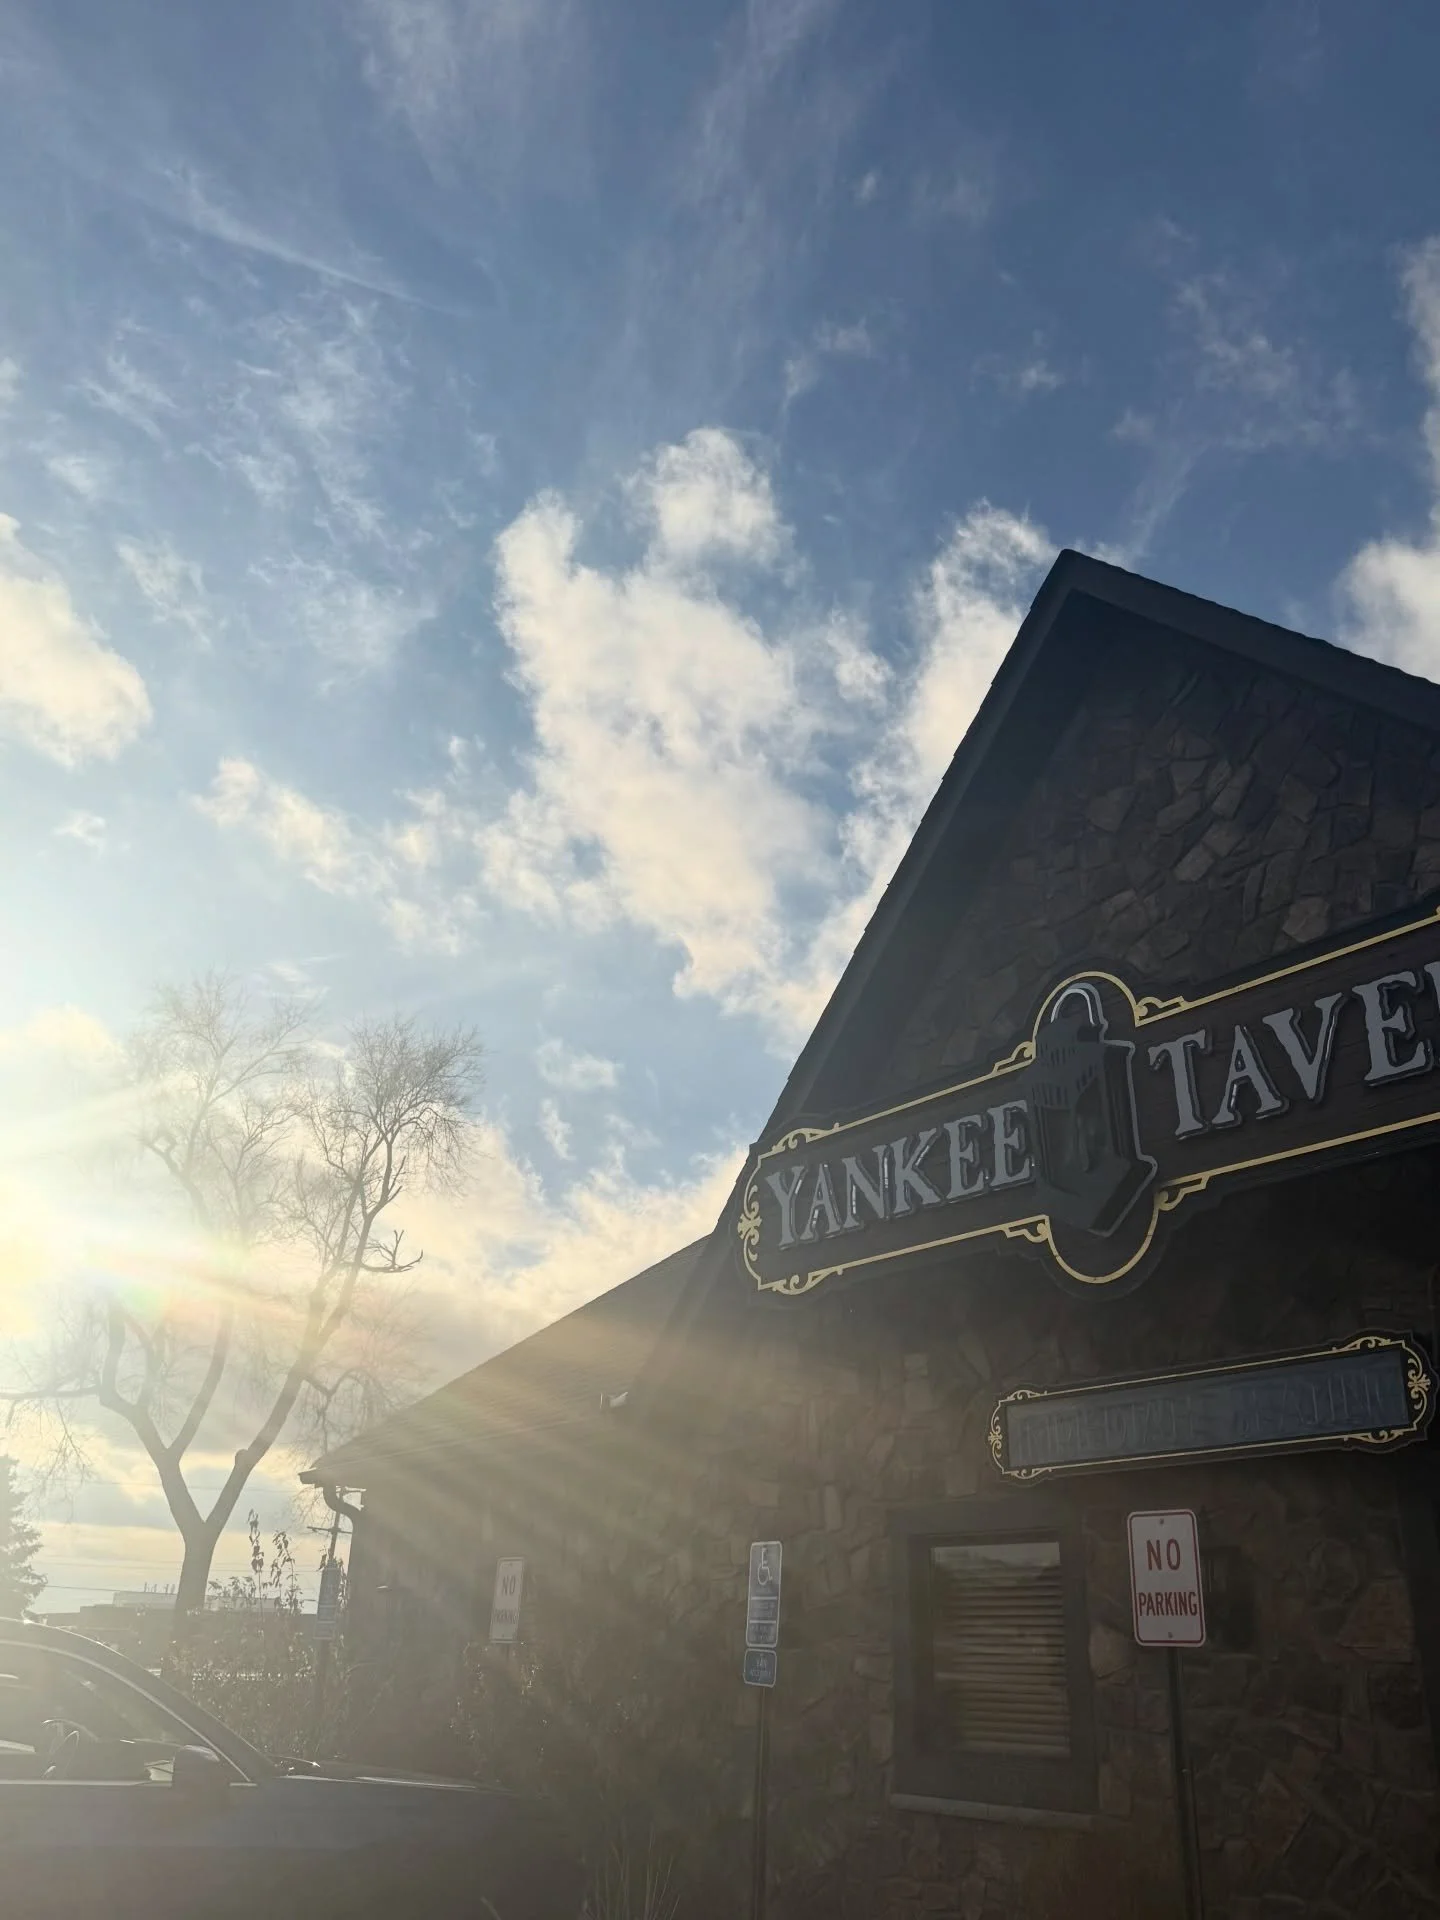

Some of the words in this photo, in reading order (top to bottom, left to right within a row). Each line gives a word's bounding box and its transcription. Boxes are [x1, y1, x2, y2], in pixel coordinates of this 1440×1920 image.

[767, 1098, 1036, 1249] YANKEE
[1146, 1538, 1181, 1571] NO
[501, 1574, 517, 1597] NO
[1138, 1591, 1198, 1616] PARKING
